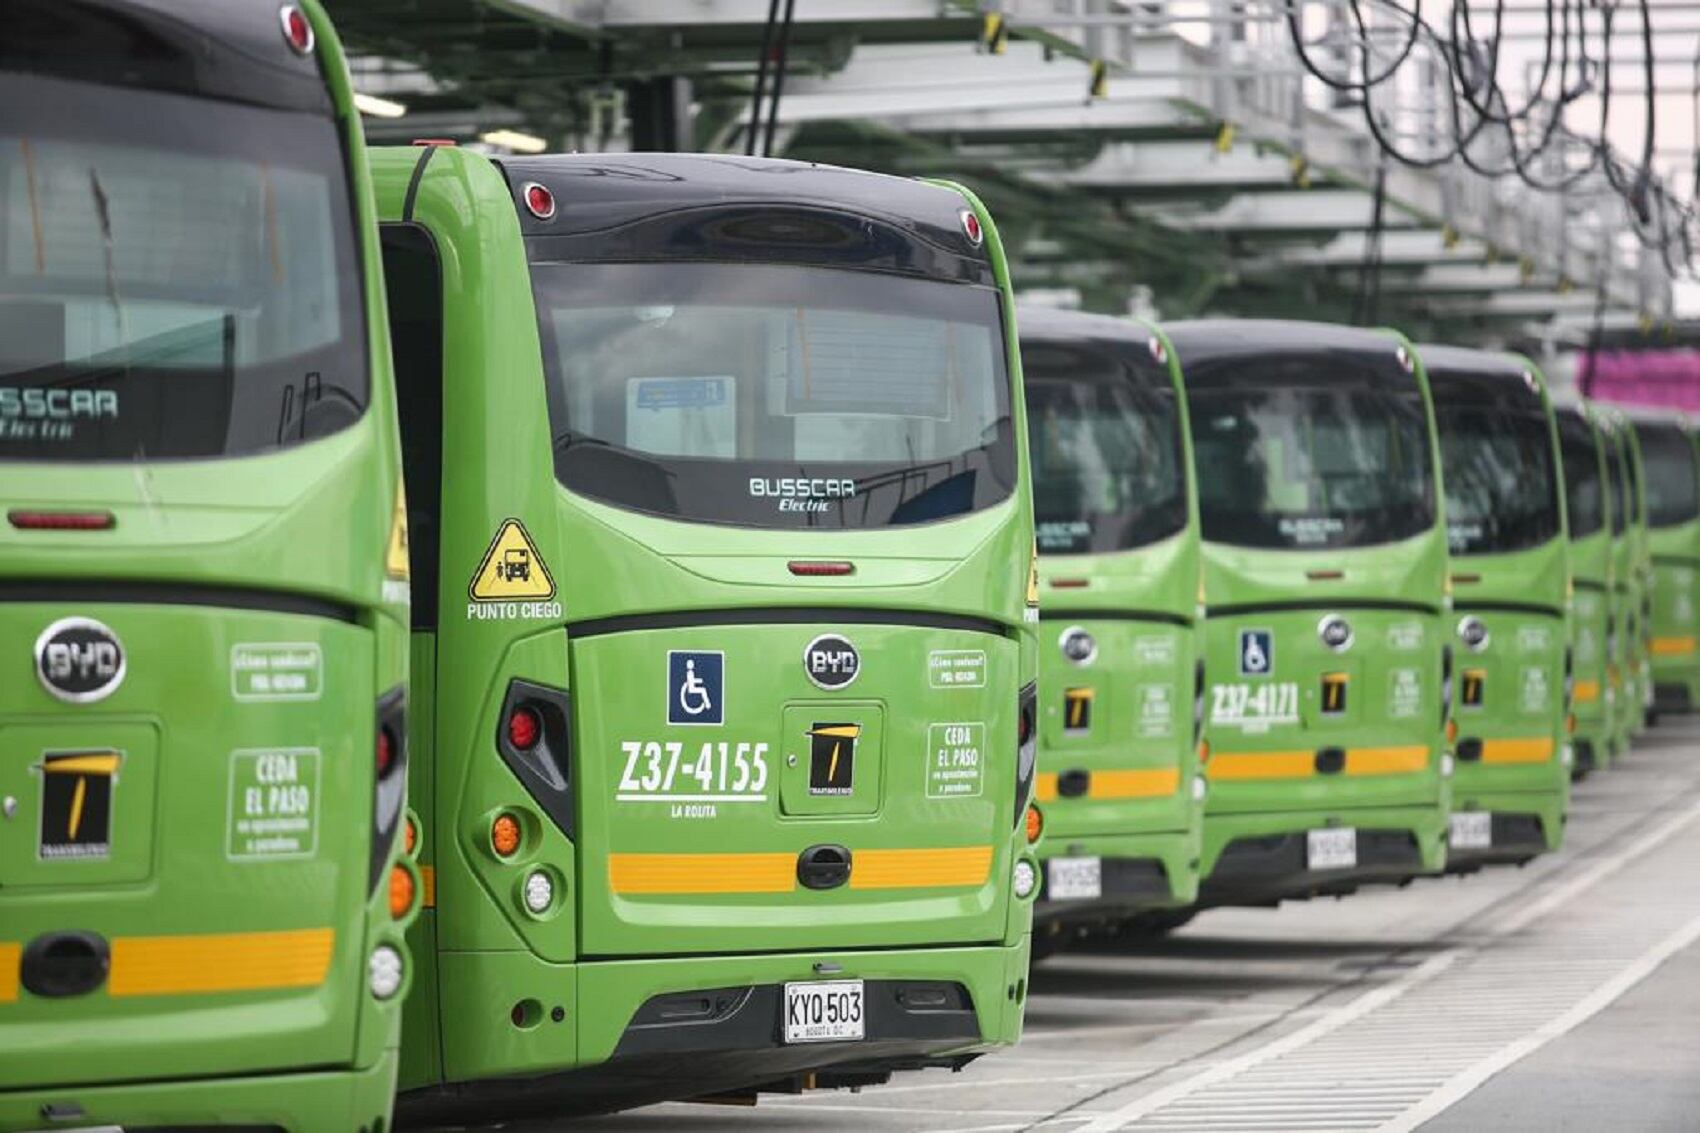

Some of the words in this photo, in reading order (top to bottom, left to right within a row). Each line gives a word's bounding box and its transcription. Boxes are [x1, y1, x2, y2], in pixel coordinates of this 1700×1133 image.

[749, 478, 855, 497] BUSSCAR
[779, 498, 829, 512] Electric
[467, 603, 517, 619] PUNTO
[521, 602, 562, 618] CIEGO
[48, 641, 117, 678] BYD
[812, 650, 854, 673] BYD
[945, 727, 971, 746] CEDA
[618, 741, 769, 791] Z37-4155
[938, 749, 950, 767] EL
[953, 747, 978, 767] PASO
[256, 754, 297, 783] CEDA
[269, 784, 309, 814] PASO
[671, 805, 683, 818] LA
[789, 993, 822, 1025] KYQ
[827, 991, 861, 1023] 503
